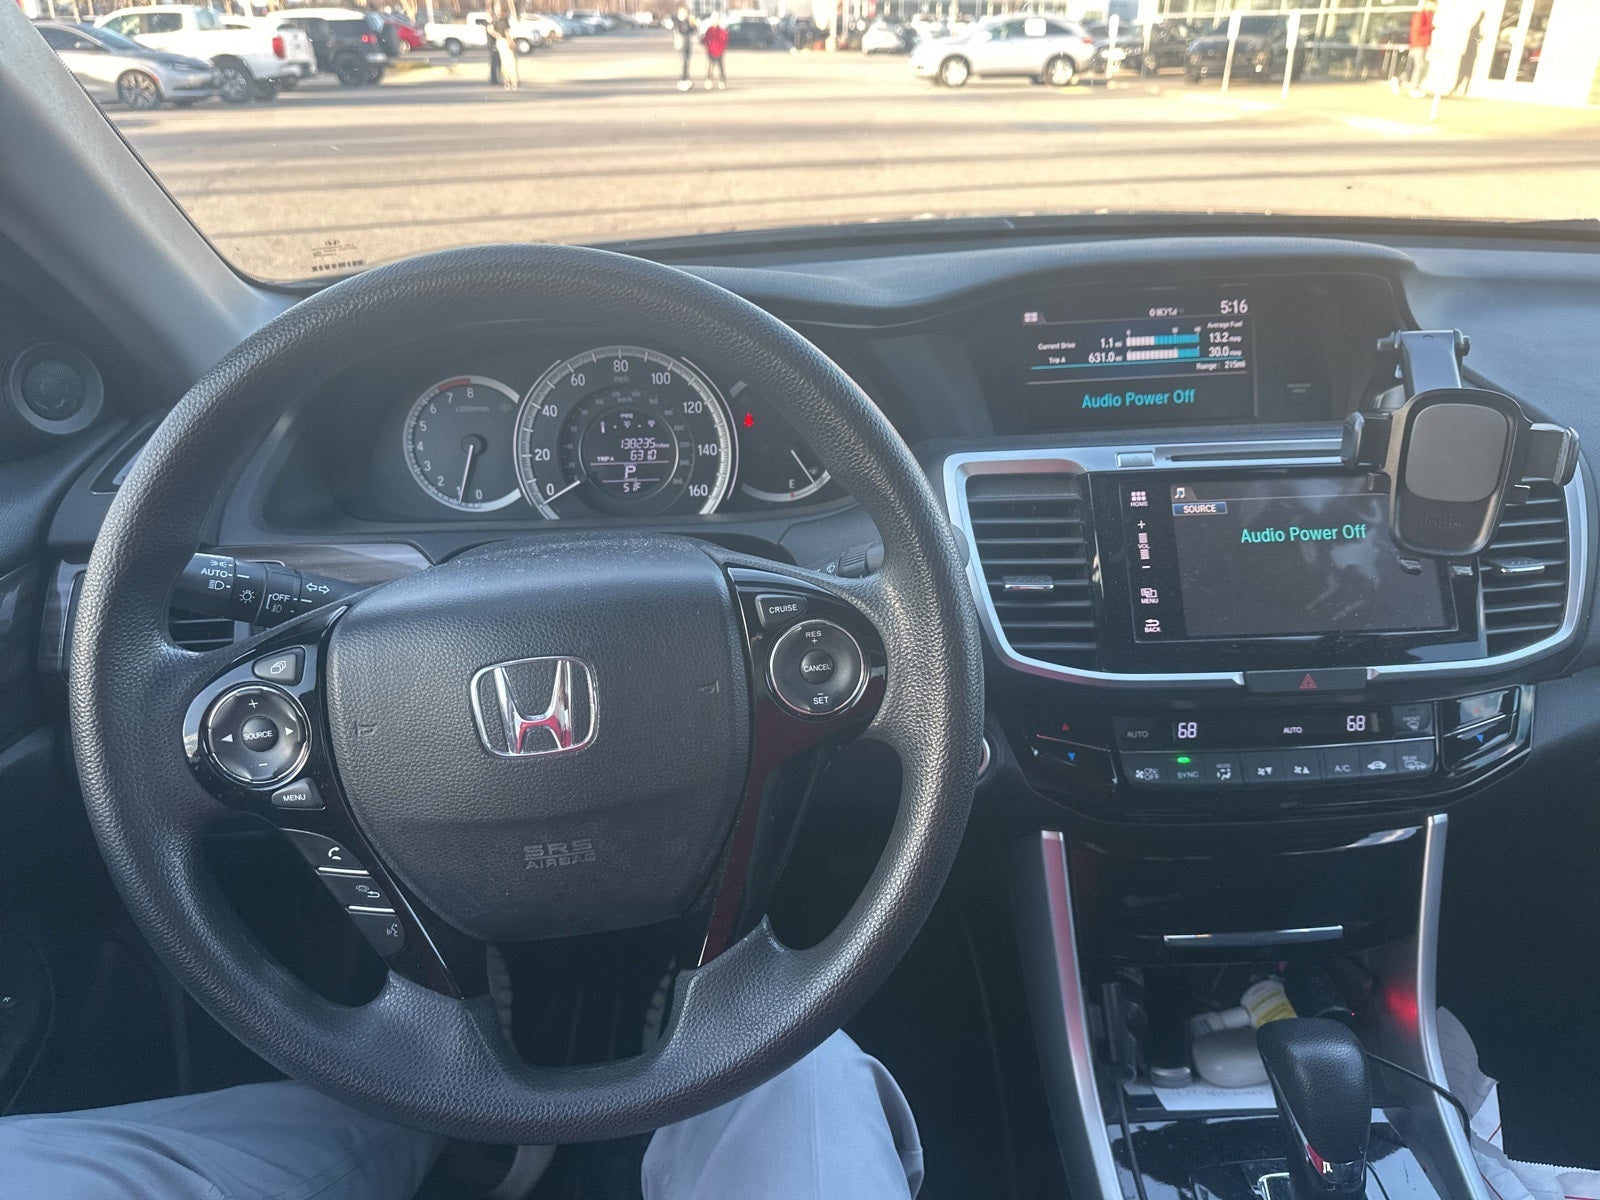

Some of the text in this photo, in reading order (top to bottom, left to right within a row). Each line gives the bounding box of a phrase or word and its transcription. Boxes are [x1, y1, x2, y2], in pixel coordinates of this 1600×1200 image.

[1220, 299, 1249, 314] 5:16
[1209, 332, 1230, 343] 13.2
[1088, 351, 1115, 363] 631.0
[1208, 346, 1230, 357] 30.0
[613, 359, 629, 373] 80
[571, 373, 585, 386] 60
[651, 372, 671, 385] 100
[447, 393, 453, 404] 7
[467, 388, 474, 399] 8
[1082, 388, 1196, 409] Audio Power Off
[430, 403, 437, 414] 6
[542, 404, 558, 417] 40
[683, 401, 703, 414] 120
[419, 420, 427, 431] 5
[417, 441, 424, 451] 4
[621, 437, 656, 449] 138235
[534, 448, 550, 461] 20
[698, 443, 718, 456] 140
[424, 460, 431, 471] 3
[625, 465, 637, 479] P
[437, 475, 445, 487] 2
[789, 479, 795, 488] E
[475, 489, 483, 500] 0
[546, 483, 555, 496] 0
[688, 484, 708, 497] 160
[1183, 504, 1217, 514] SOURCE
[1240, 523, 1367, 544] Audio Power Off
[201, 567, 228, 578] AUTO
[272, 592, 291, 603] OFF
[768, 603, 798, 614] CRUISE
[805, 630, 822, 638] RES
[803, 663, 831, 673] CANCEL
[813, 696, 829, 705] SET
[1346, 715, 1366, 732] 68
[243, 730, 274, 741] SOURCE
[1126, 730, 1149, 739] AUTO
[1177, 722, 1198, 739] 68
[1283, 726, 1303, 734] AUTO
[1334, 764, 1351, 773] A/C
[1177, 771, 1199, 779] SYNC
[282, 793, 307, 802] MENU
[523, 839, 592, 856] SRS
